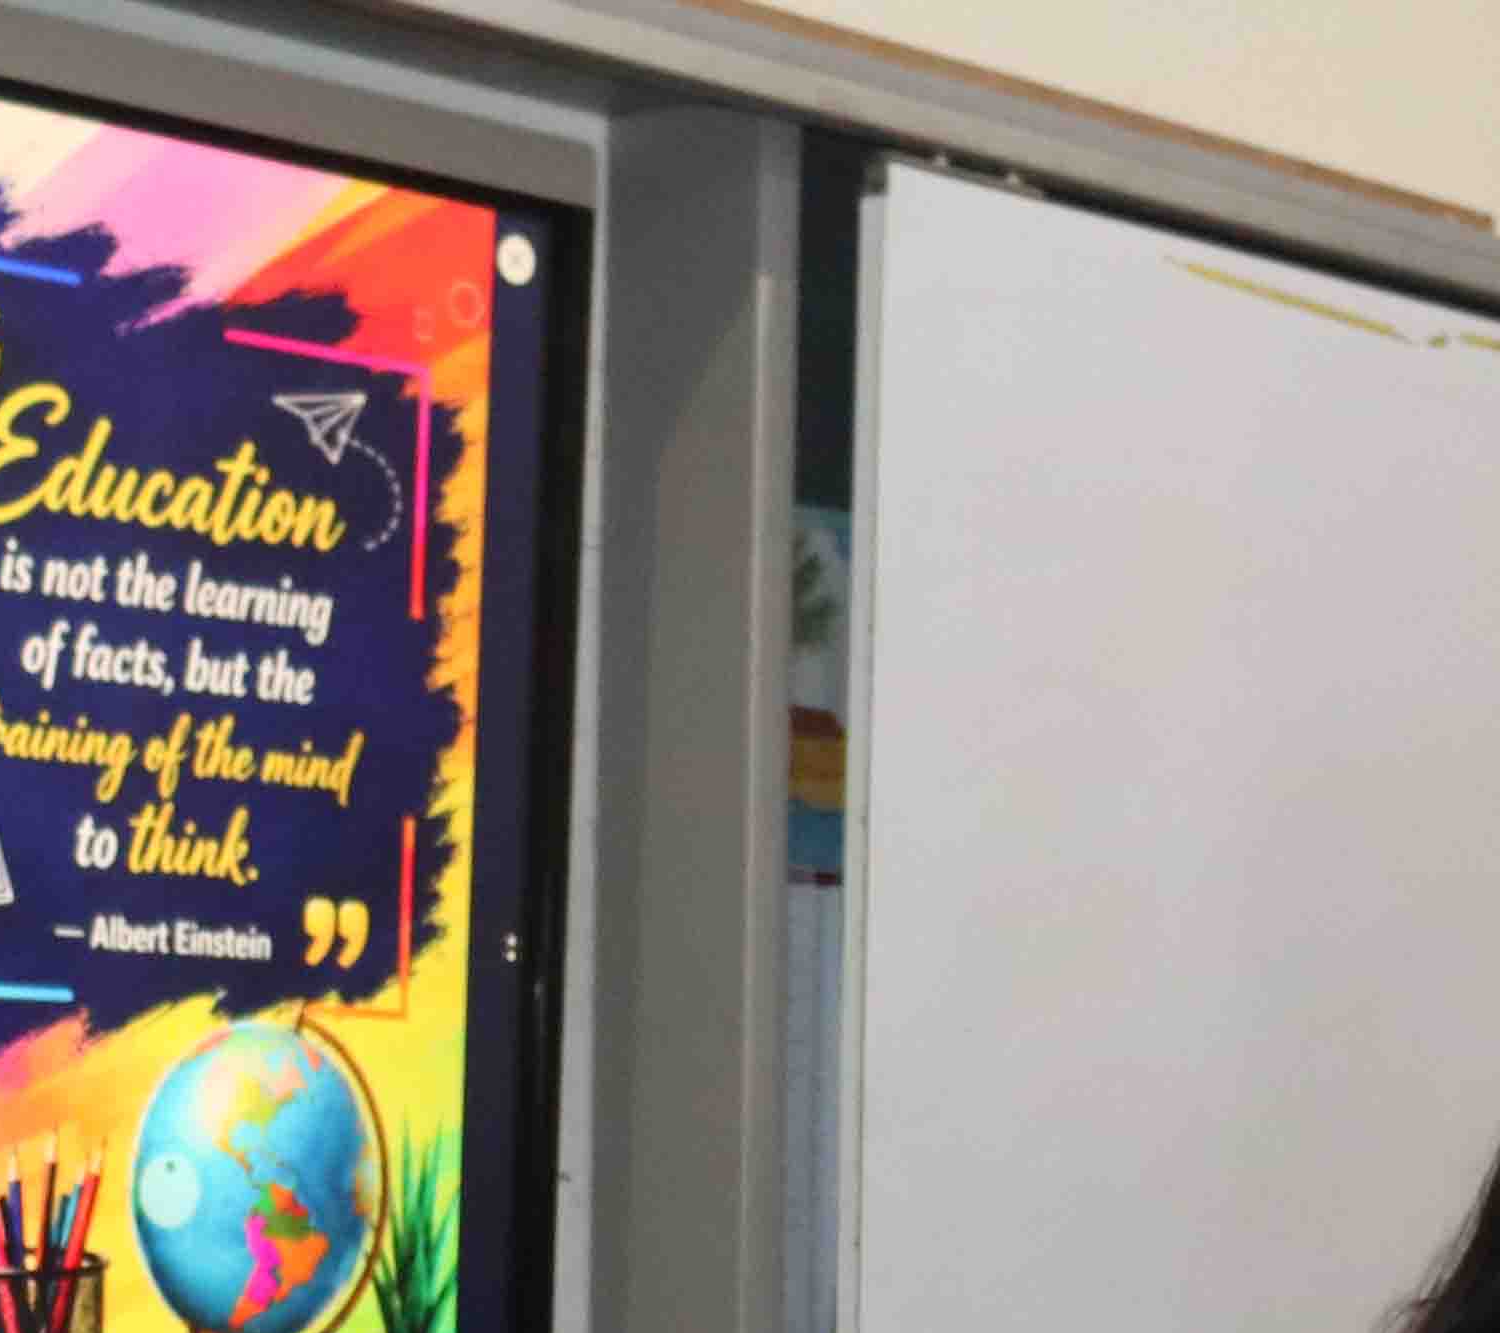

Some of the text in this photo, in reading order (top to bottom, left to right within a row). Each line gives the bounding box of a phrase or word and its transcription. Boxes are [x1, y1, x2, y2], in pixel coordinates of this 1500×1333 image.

[0, 537, 331, 643] is not the learning
[22, 622, 315, 706] of facts, but the
[144, 715, 191, 798] of
[195, 717, 255, 782] the
[262, 730, 363, 805] mind
[75, 805, 259, 884] to think.
[91, 916, 169, 954] Albert
[174, 923, 272, 961] Einstein
